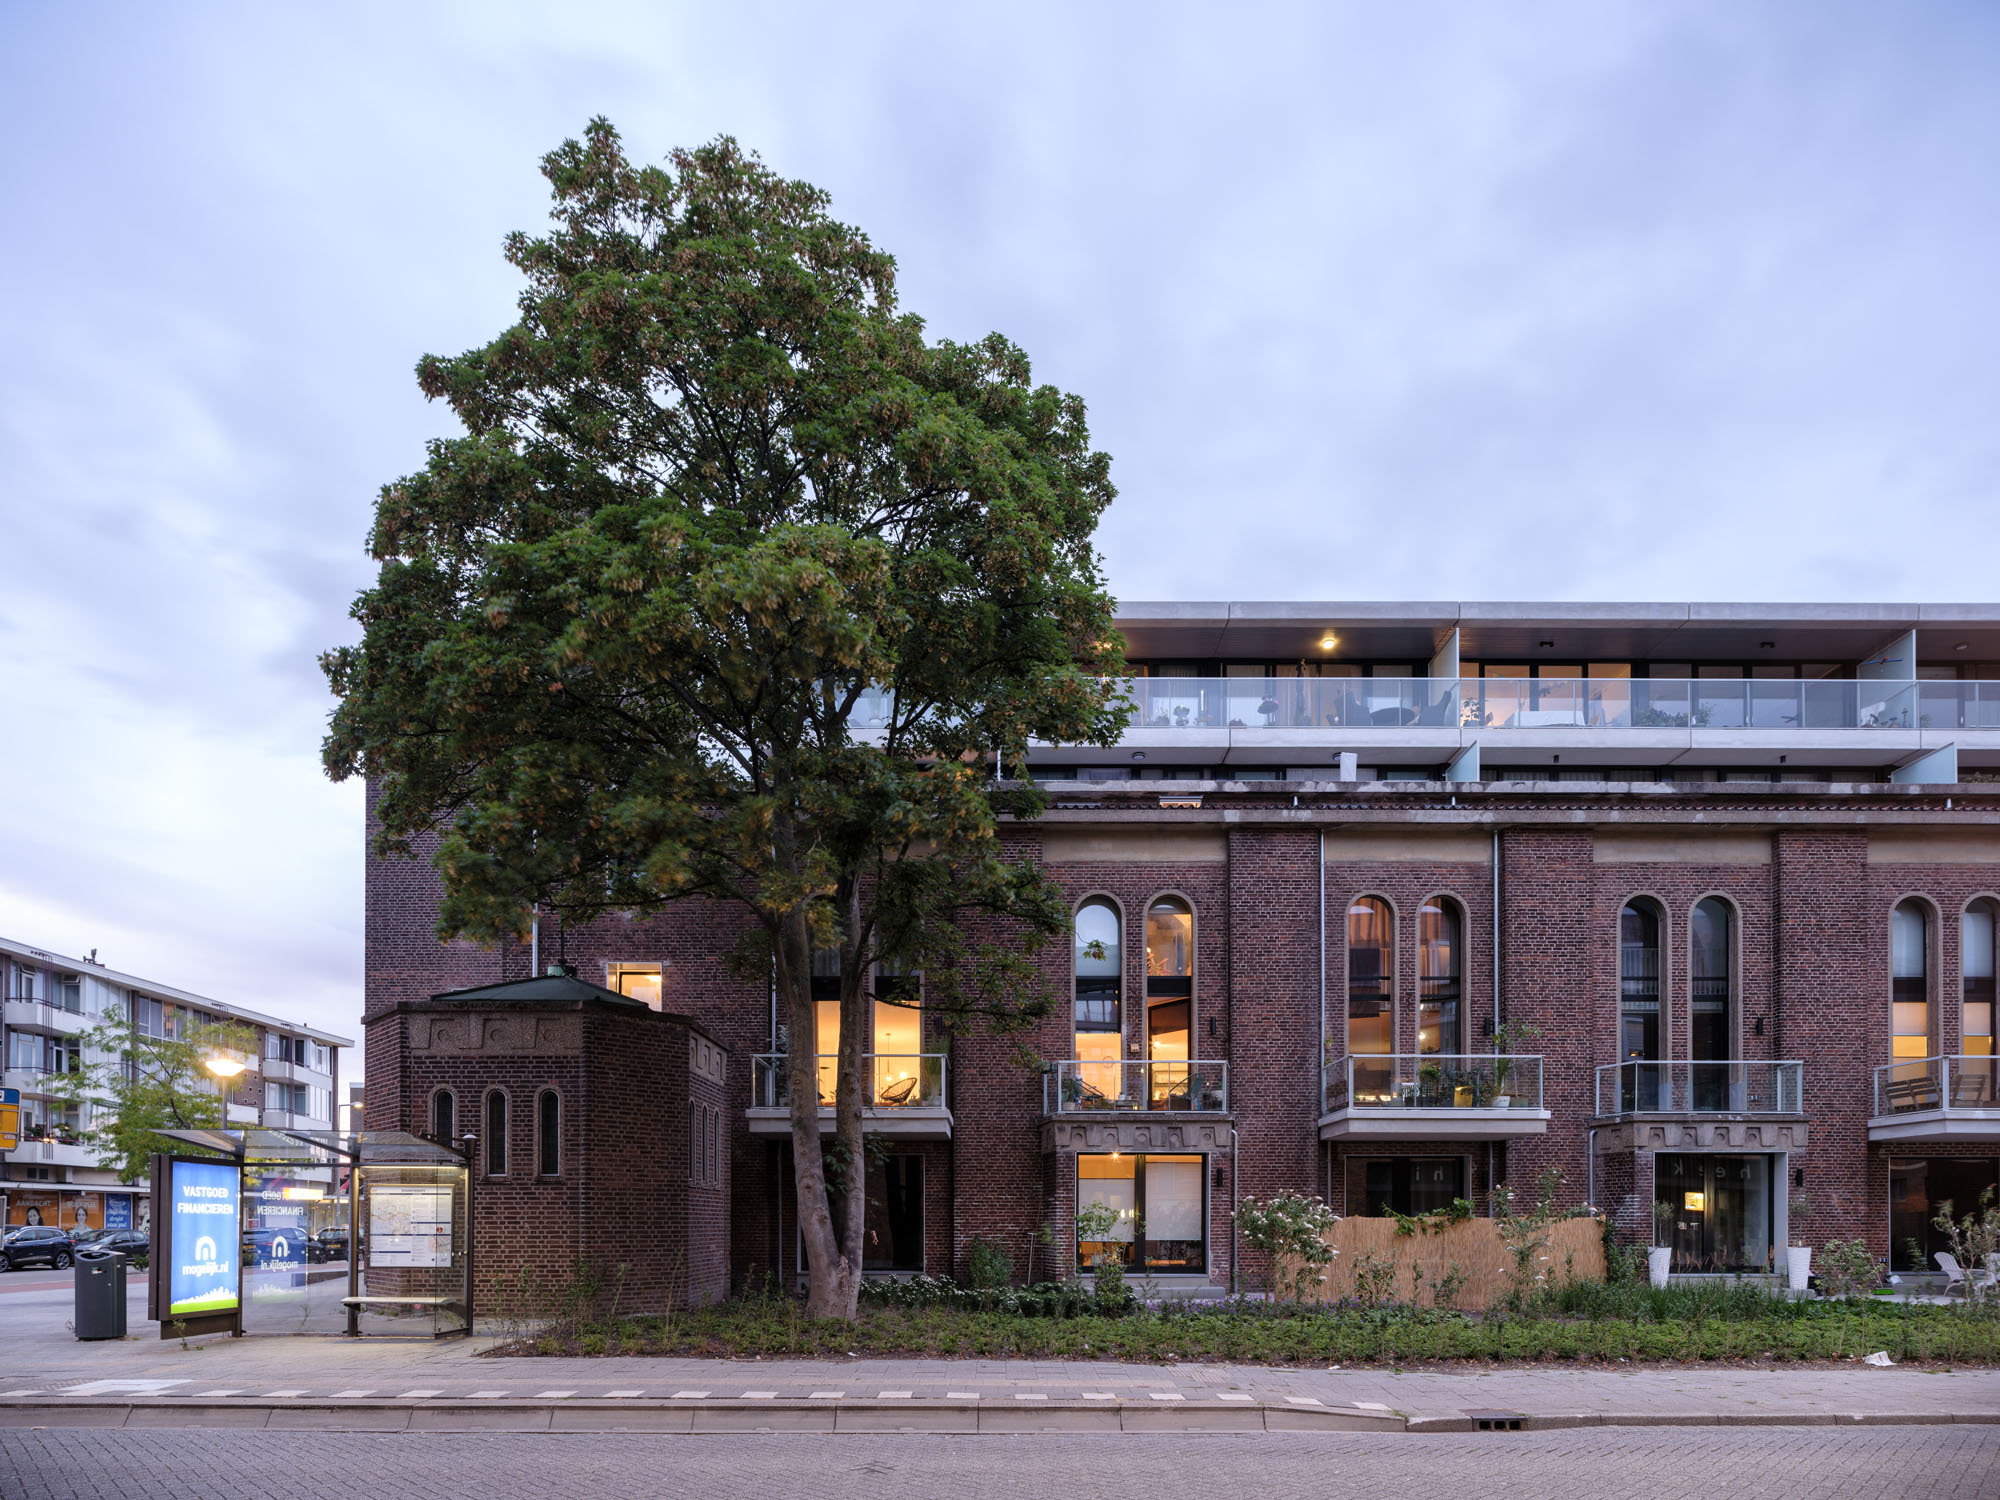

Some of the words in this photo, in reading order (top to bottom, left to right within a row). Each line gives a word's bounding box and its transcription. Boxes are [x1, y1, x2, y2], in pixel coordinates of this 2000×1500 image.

[183, 1186, 228, 1198] VASTGOED
[177, 1203, 233, 1215] FINANCIEREN
[183, 1261, 228, 1277] mogelijk.nl
